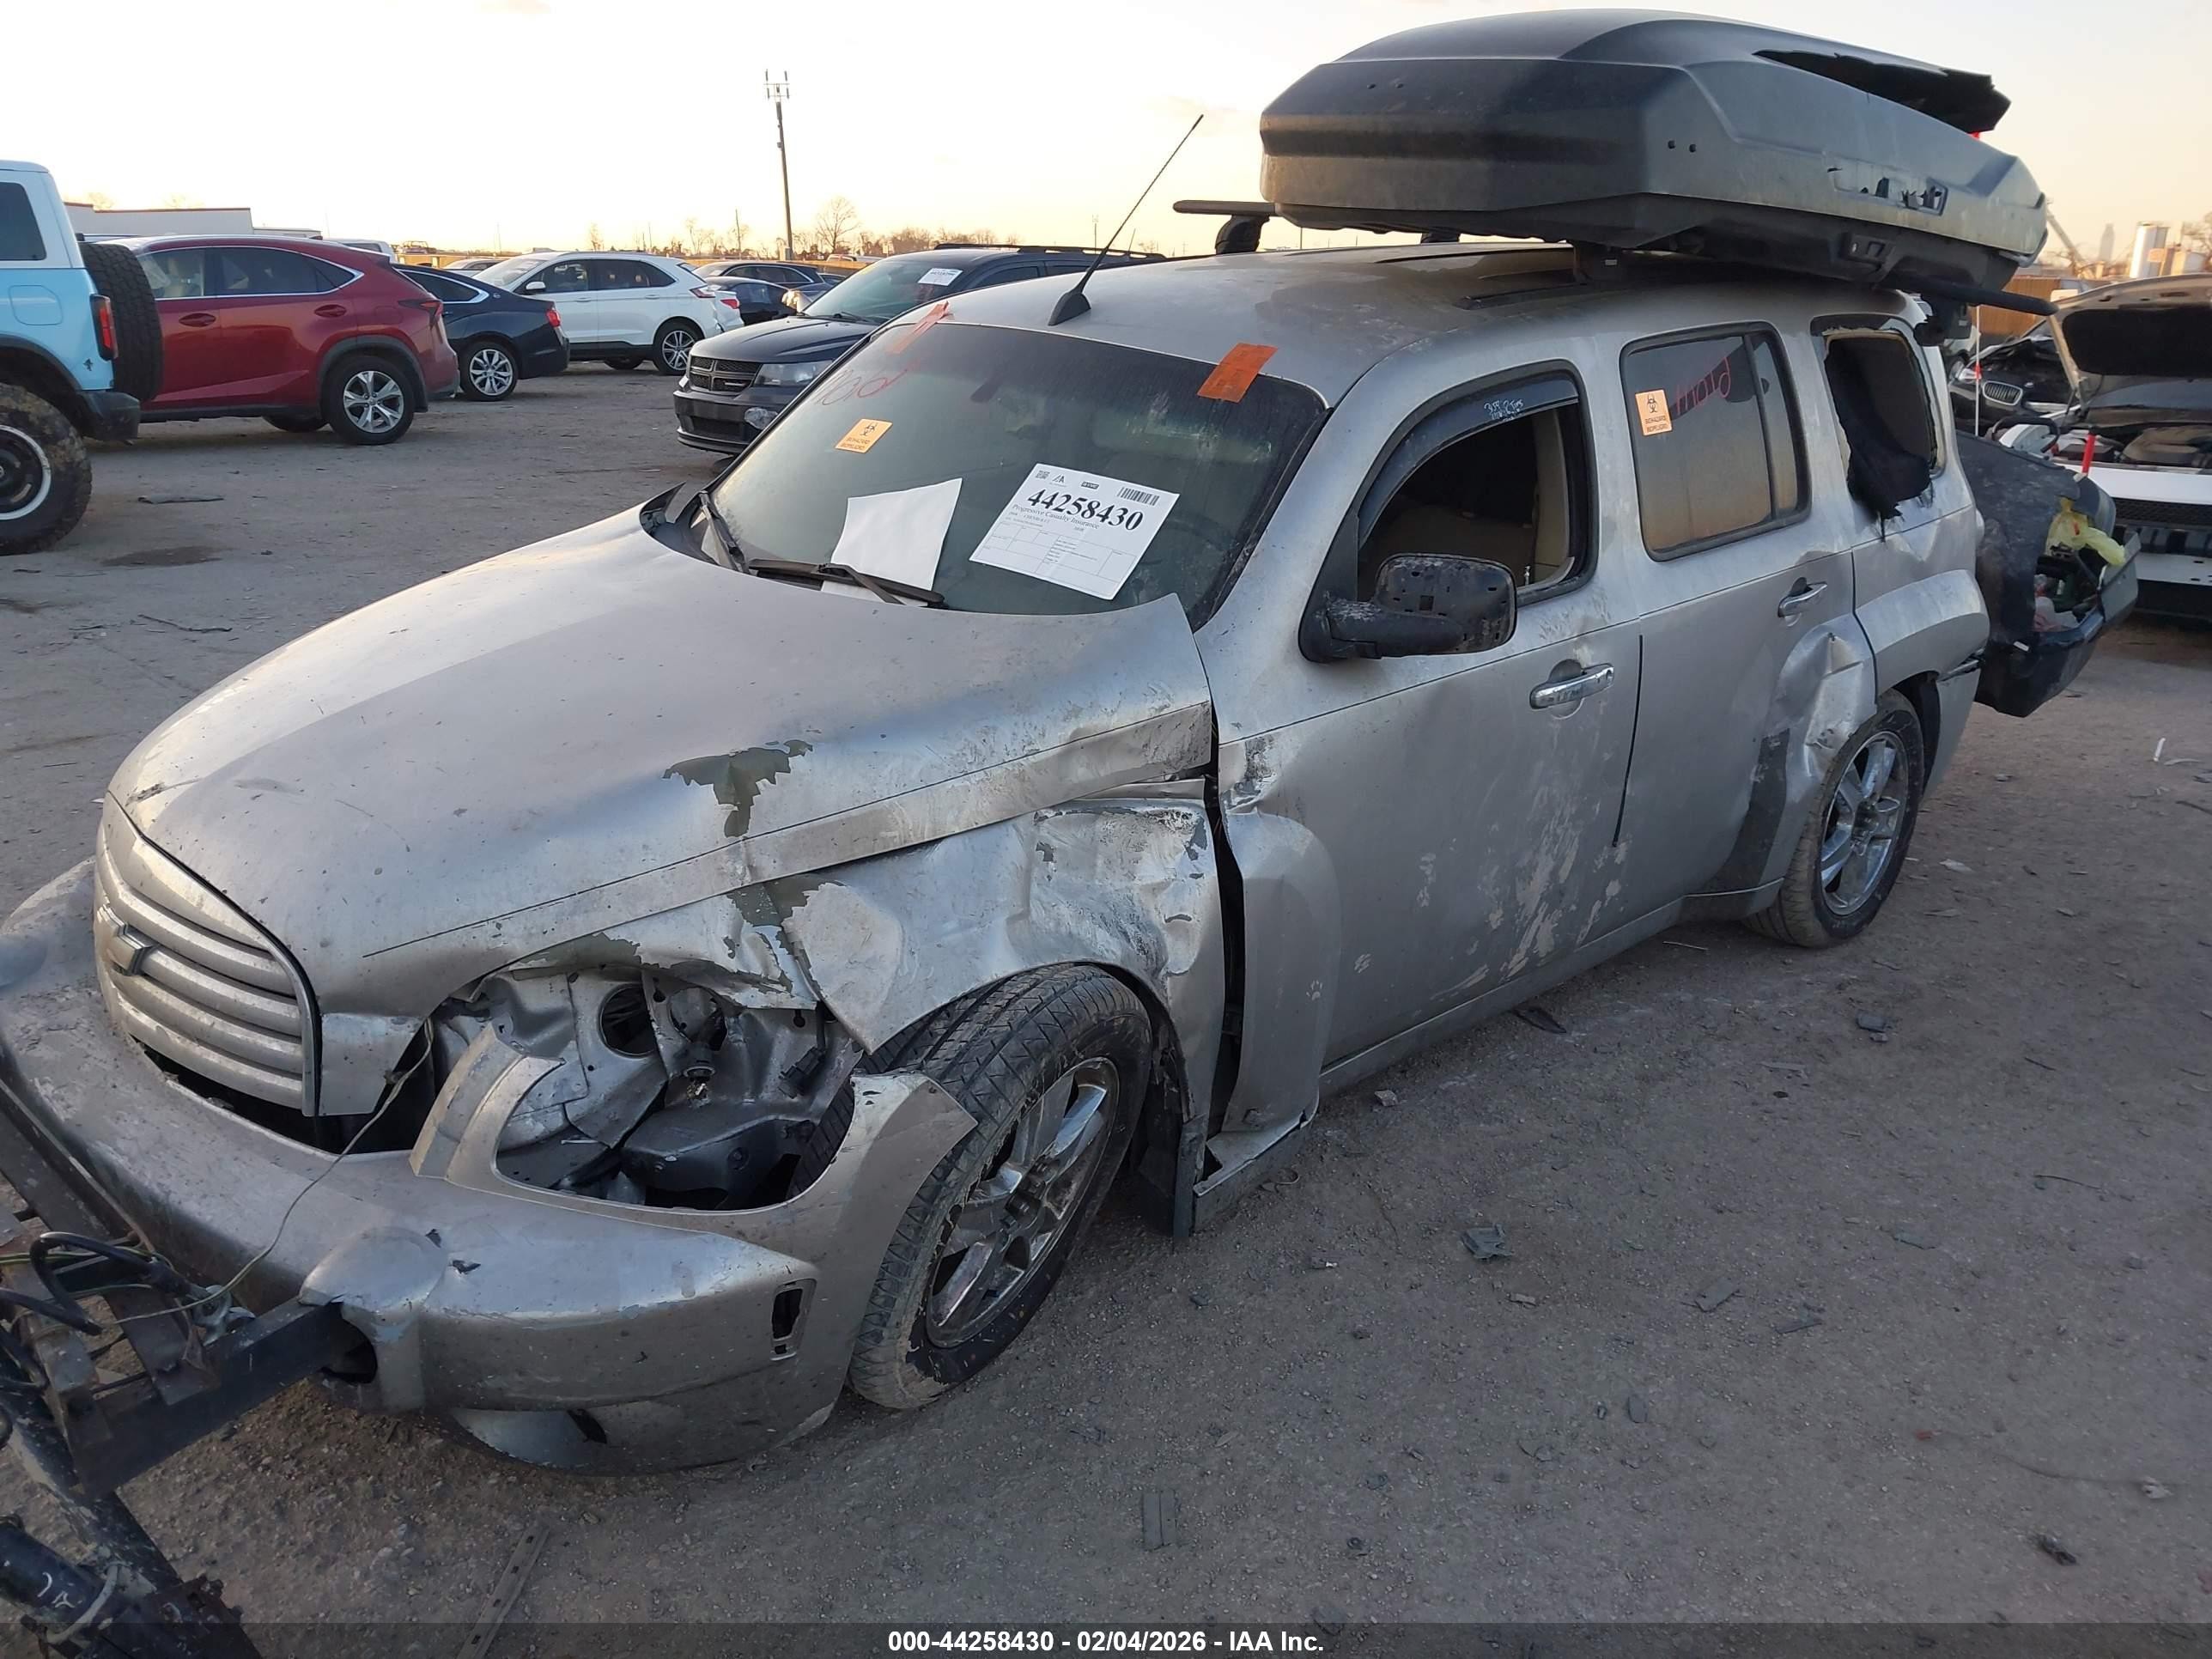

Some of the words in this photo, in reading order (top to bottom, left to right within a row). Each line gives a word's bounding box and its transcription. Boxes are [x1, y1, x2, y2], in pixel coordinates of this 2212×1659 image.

[1012, 504, 1045, 517] Progressive
[1045, 510, 1069, 523] Casualty
[1070, 517, 1099, 530] Insurance
[1028, 489, 1144, 531] 44258430
